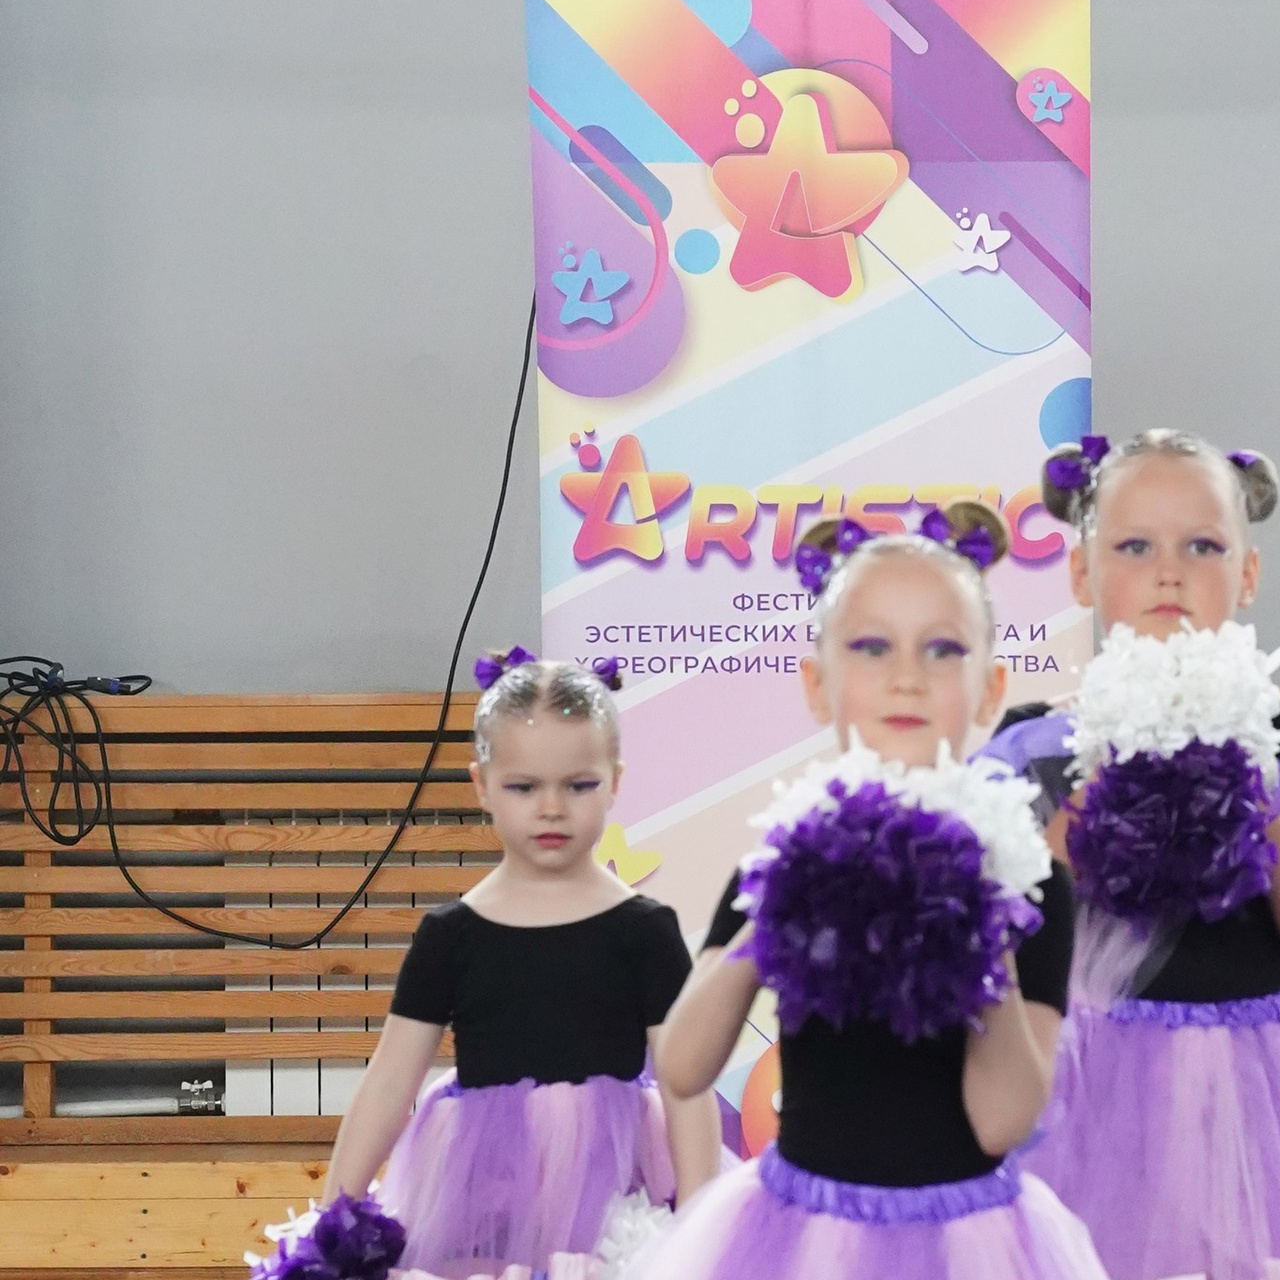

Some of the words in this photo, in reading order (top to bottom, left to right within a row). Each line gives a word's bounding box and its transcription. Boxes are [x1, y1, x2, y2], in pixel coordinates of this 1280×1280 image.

[559, 434, 1066, 563] ARTSTC
[732, 592, 819, 612] ФЕСТИ
[585, 624, 797, 643] ЭСТЕТИЧЕСКИХ
[1029, 623, 1047, 642] И
[575, 655, 806, 675] РЕОГРАФИЧЕ
